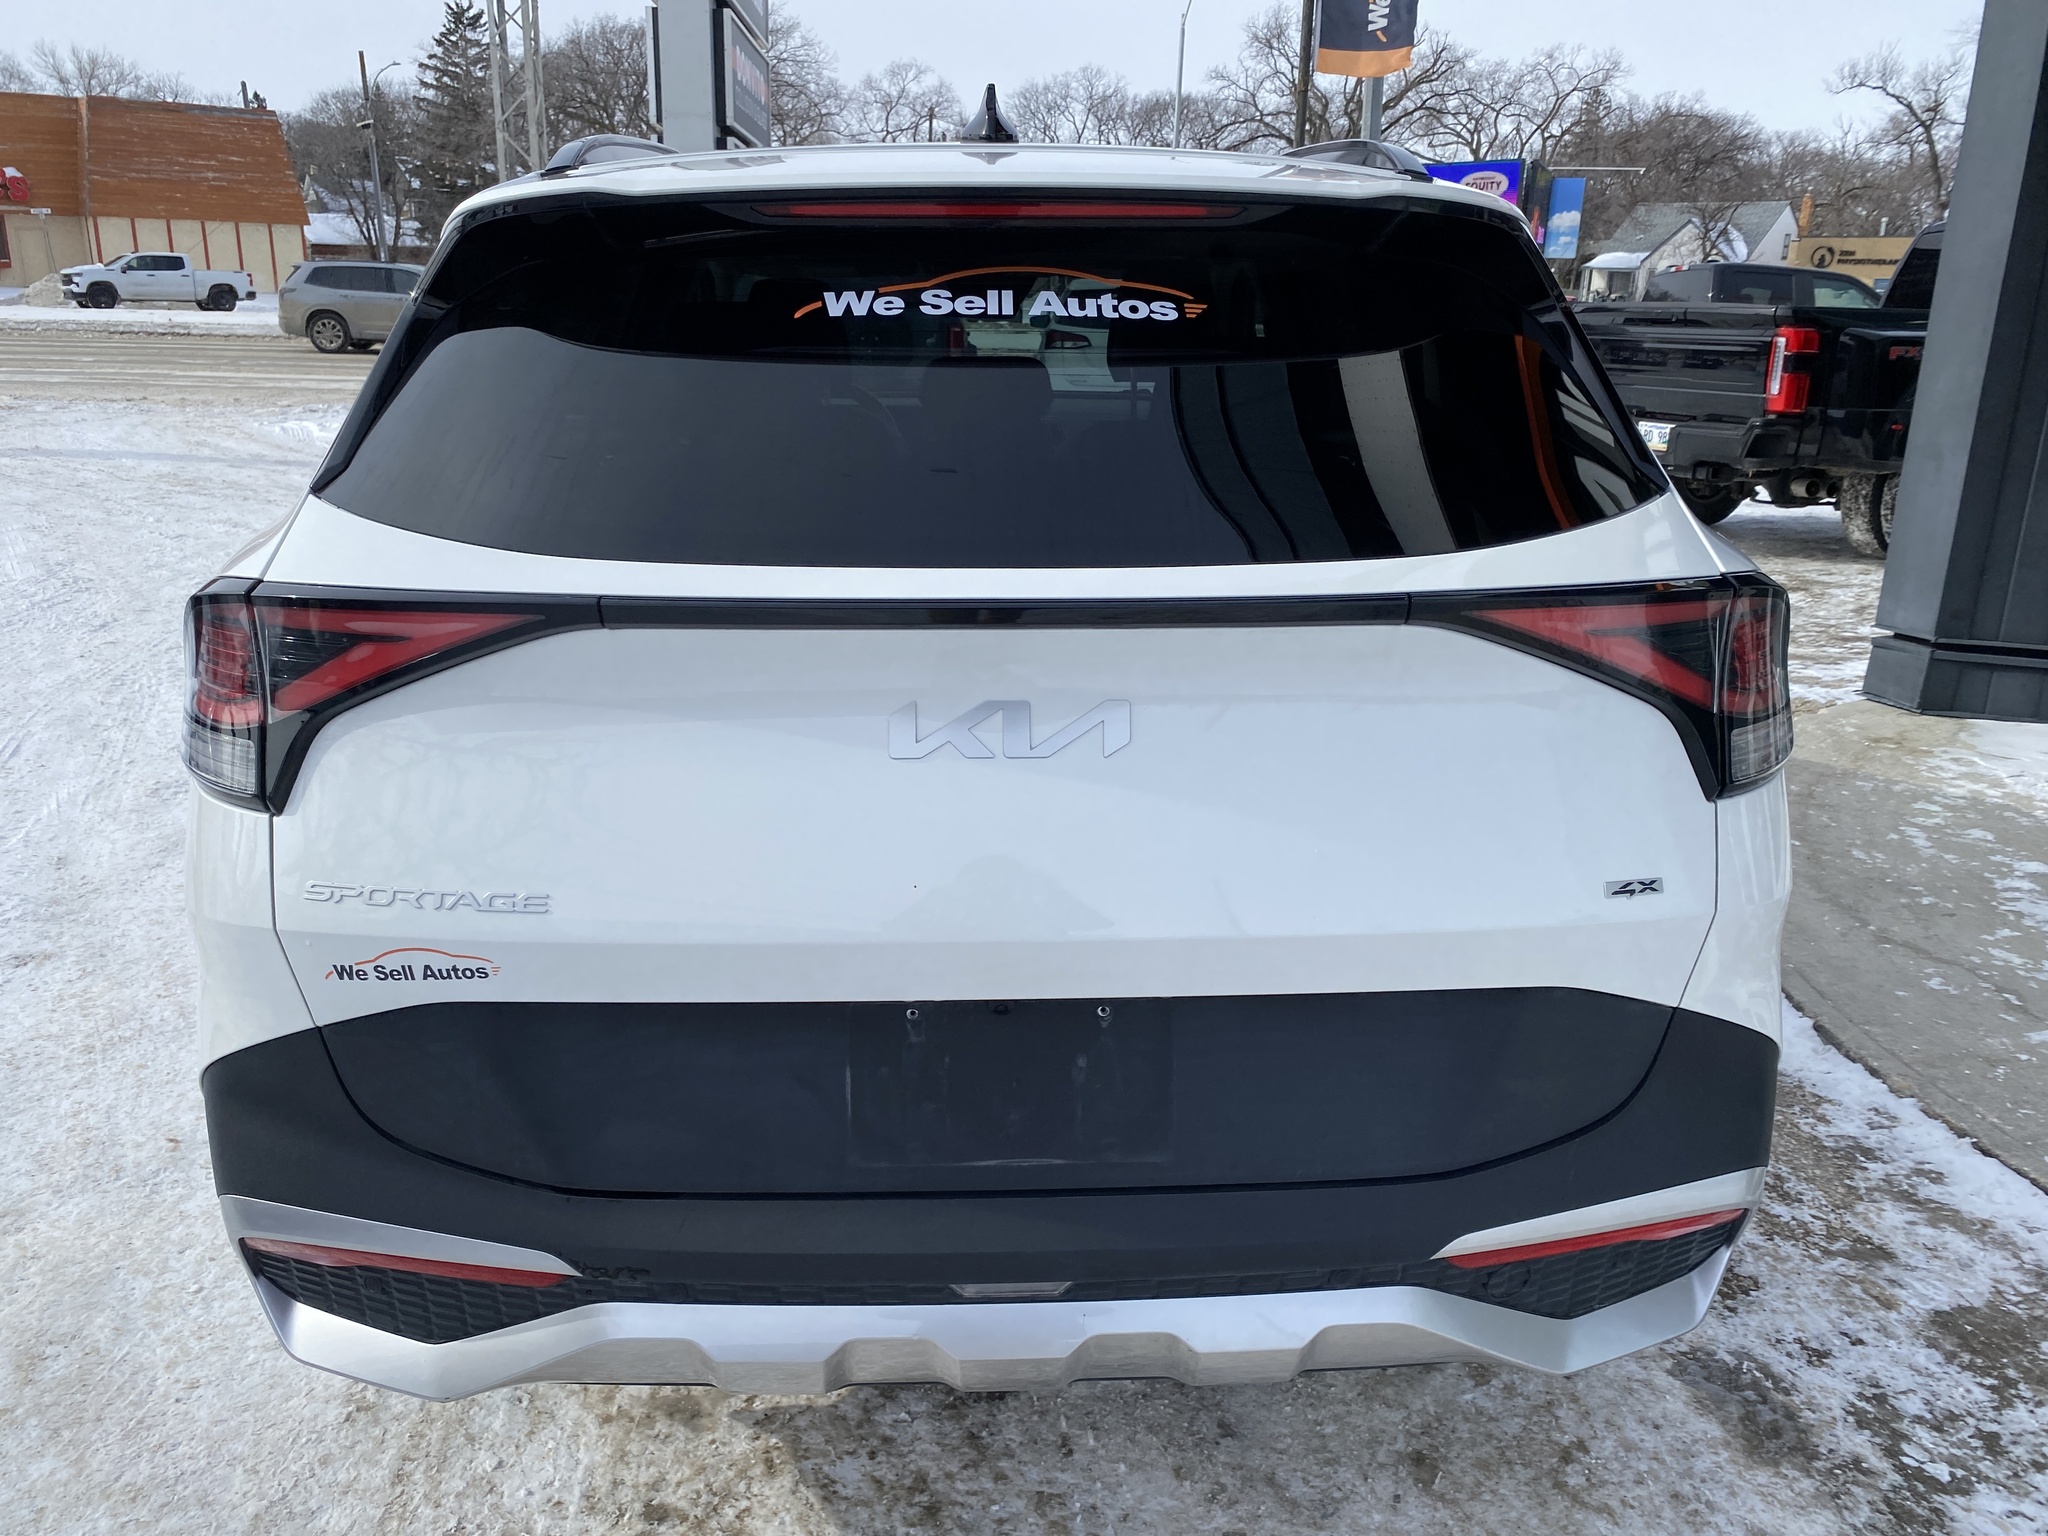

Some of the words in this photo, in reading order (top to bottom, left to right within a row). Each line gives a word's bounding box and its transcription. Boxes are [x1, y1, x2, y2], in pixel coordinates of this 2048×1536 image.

[823, 290, 905, 317] We
[918, 289, 1014, 316] Sell
[1028, 291, 1179, 321] Autos
[303, 880, 552, 914] SPORTAGE
[332, 964, 369, 981] We
[373, 965, 416, 981] Sell
[422, 964, 490, 981] Autos
